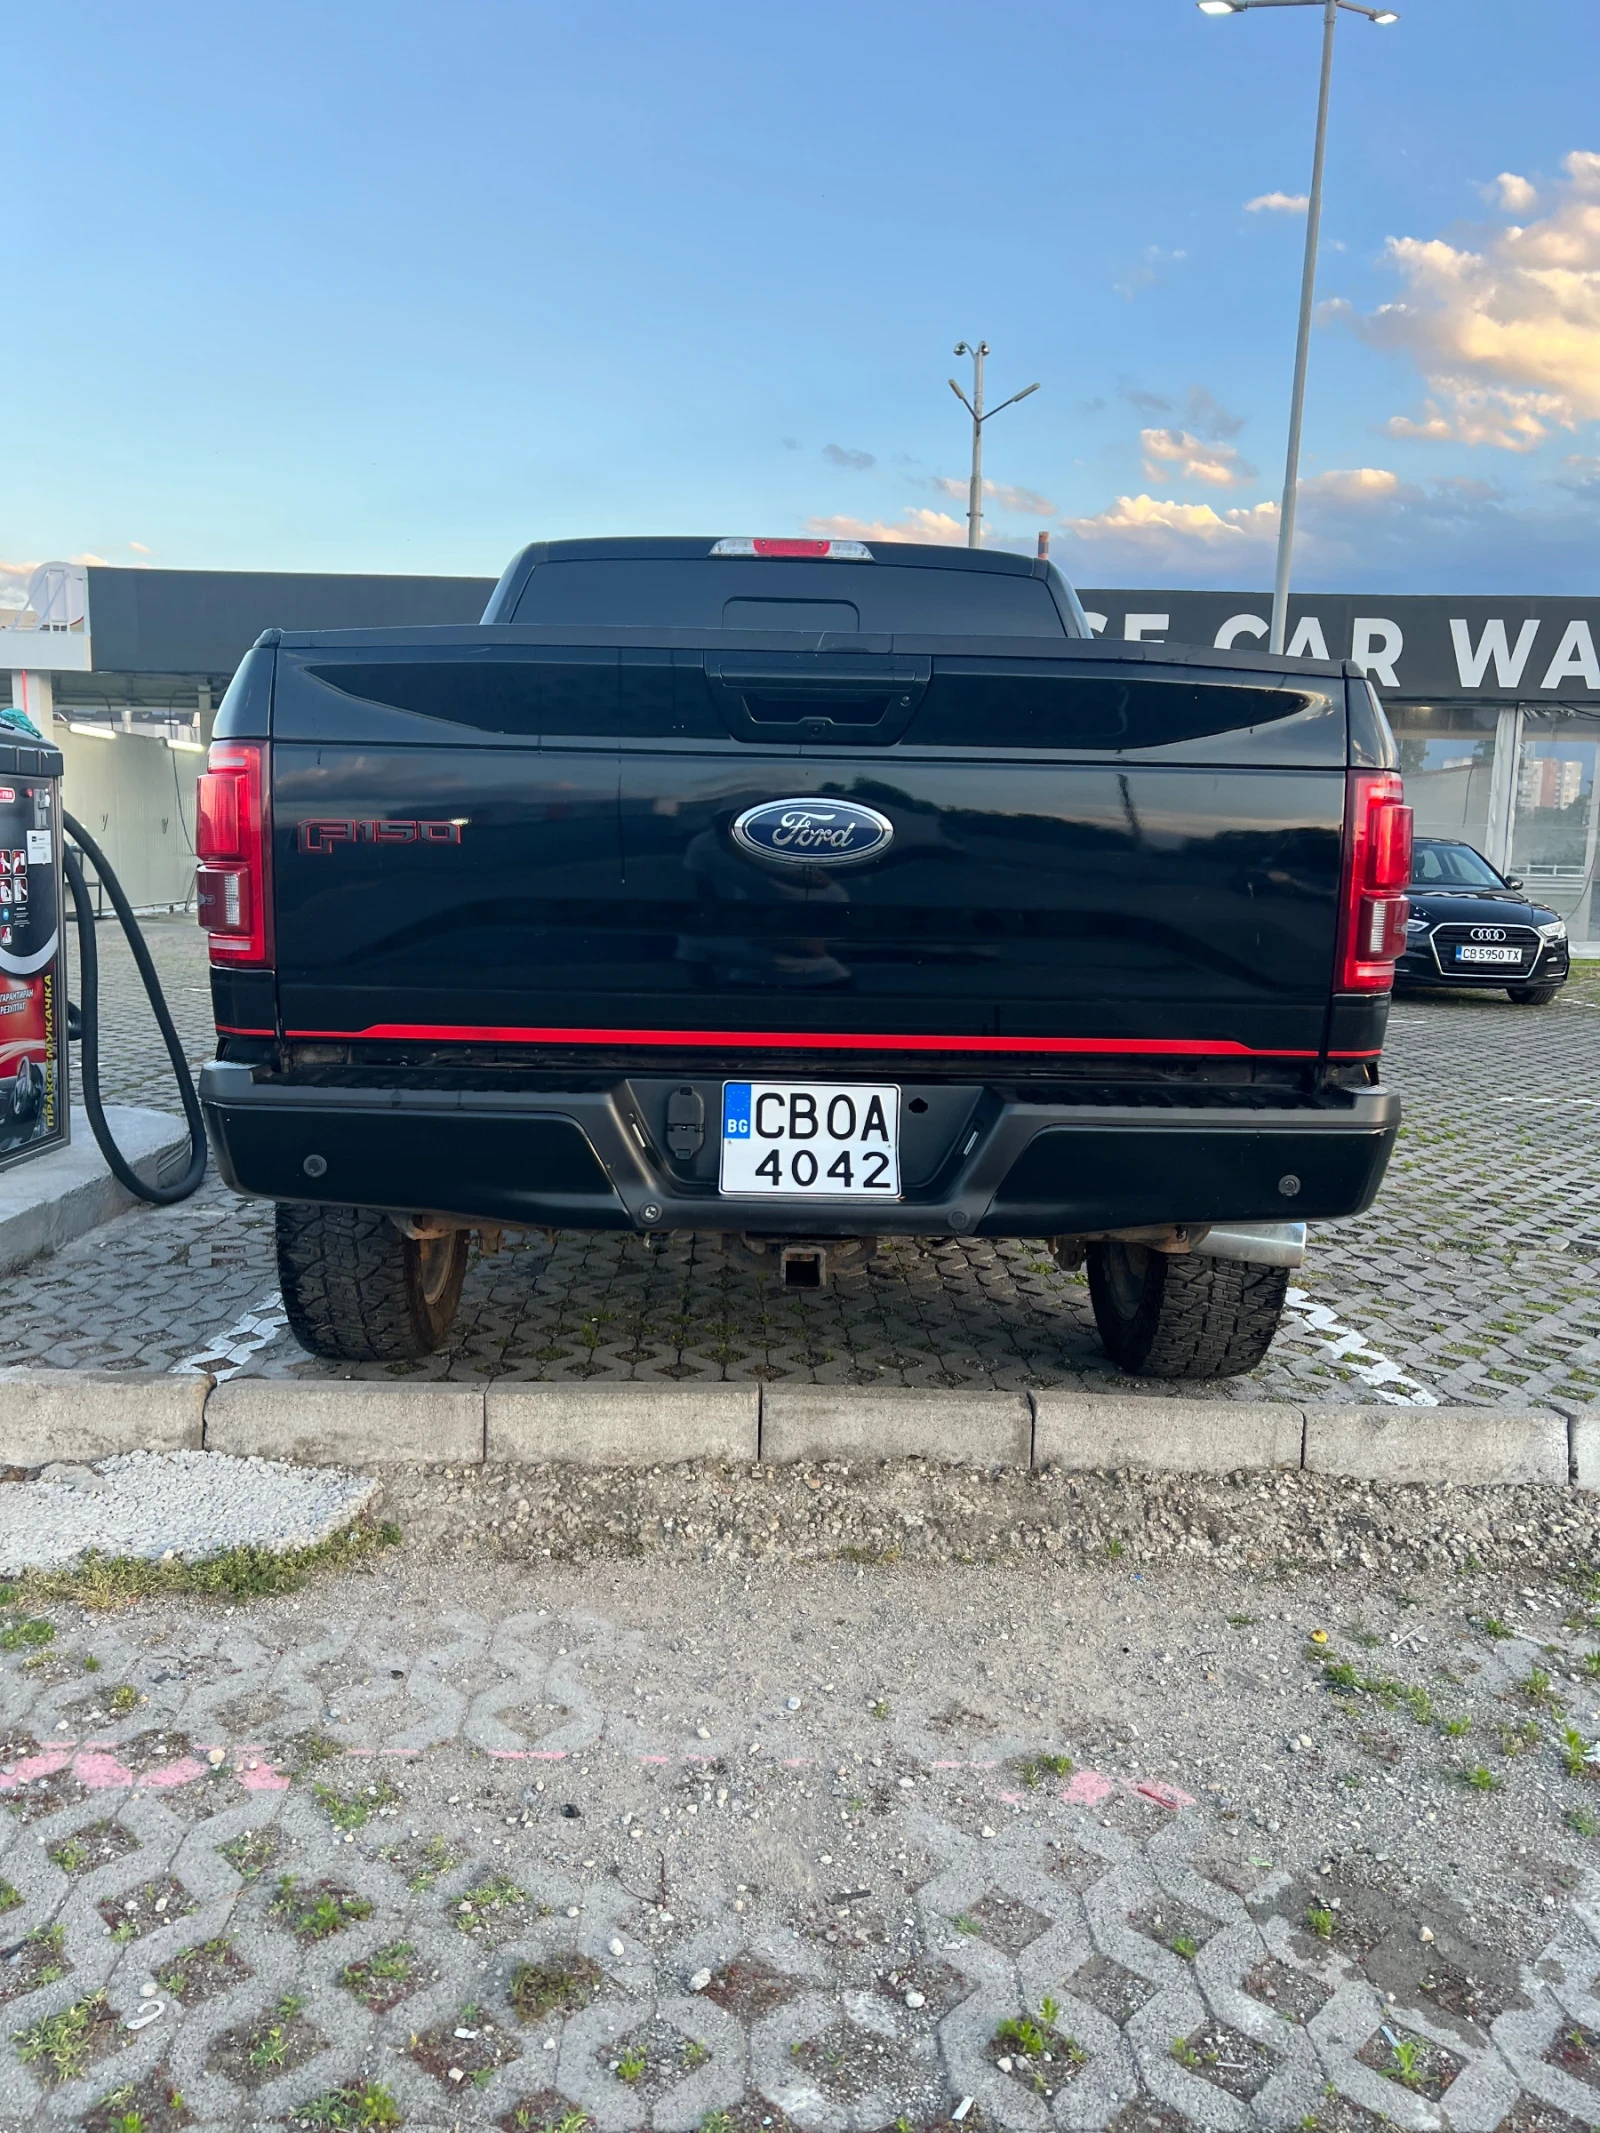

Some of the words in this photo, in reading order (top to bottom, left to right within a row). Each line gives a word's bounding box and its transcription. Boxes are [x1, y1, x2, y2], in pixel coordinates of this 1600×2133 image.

[1449, 618, 1600, 690] WA
[772, 811, 857, 848] Ford
[1463, 948, 1477, 959] CB
[1479, 948, 1504, 960] 5950
[1507, 950, 1520, 961] TX
[44, 974, 55, 1127] ПРАХОСМУКАЧКА
[727, 1118, 748, 1134] BG
[755, 1149, 891, 1188] 4042
